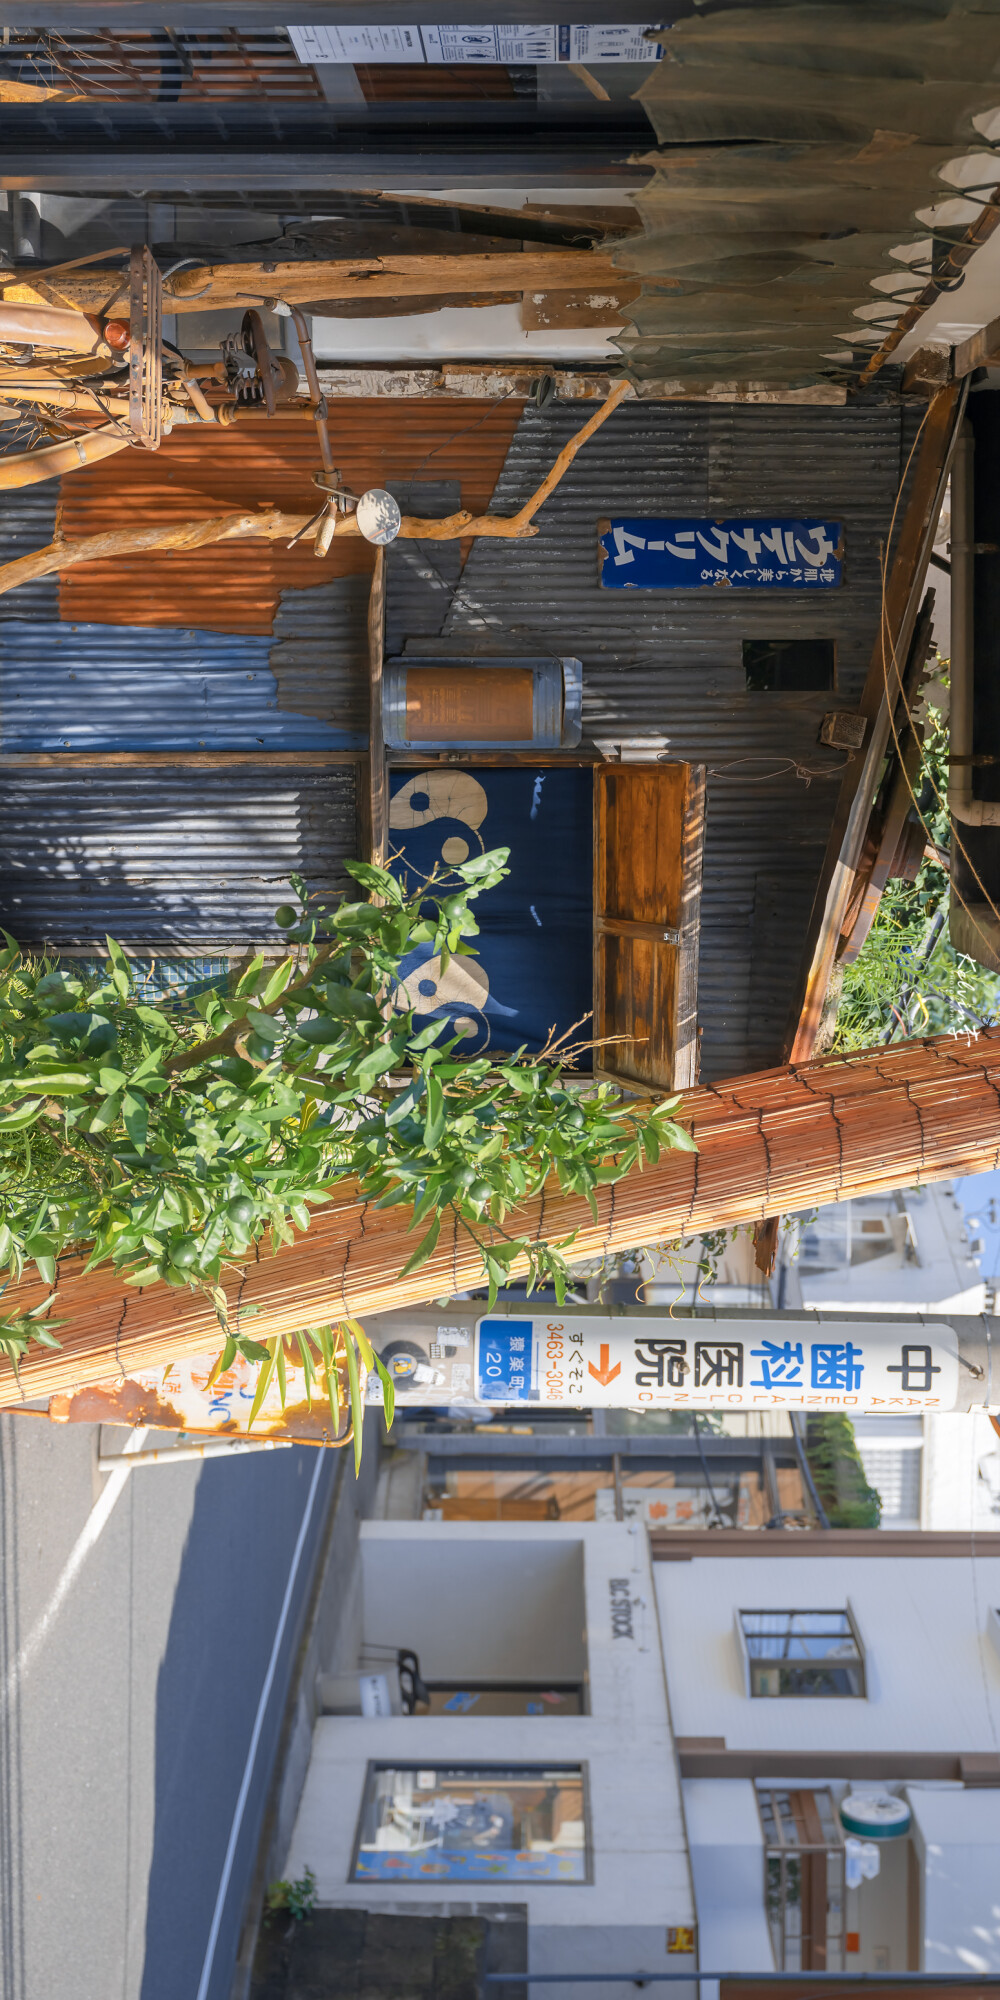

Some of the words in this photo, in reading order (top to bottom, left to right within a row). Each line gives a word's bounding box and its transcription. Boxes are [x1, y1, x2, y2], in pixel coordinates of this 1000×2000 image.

[612, 525, 833, 567] ウテナクリーム
[700, 568, 835, 583] 地肌から美しくなる
[486, 1352, 502, 1377] 20
[508, 1336, 524, 1389] 猿楽町
[546, 1323, 564, 1400] 3463-3046
[568, 1332, 584, 1394] すぐそこ
[638, 1392, 743, 1403] CLINIC
[752, 1394, 858, 1405] DENTAL
[870, 1396, 940, 1406] NAKA
[610, 1599, 634, 1640] STOCK
